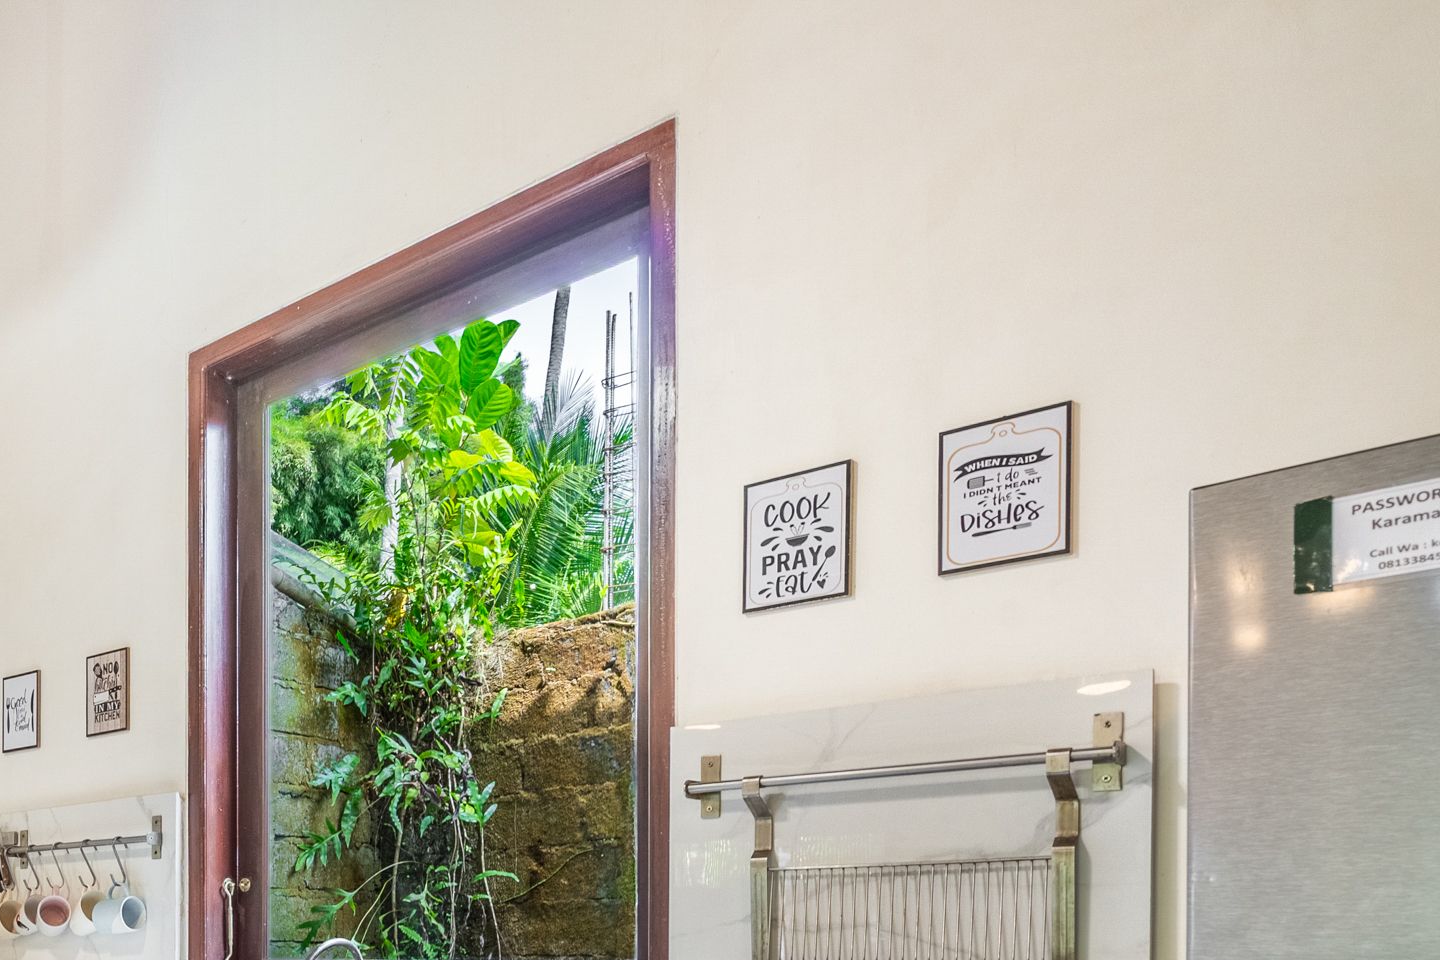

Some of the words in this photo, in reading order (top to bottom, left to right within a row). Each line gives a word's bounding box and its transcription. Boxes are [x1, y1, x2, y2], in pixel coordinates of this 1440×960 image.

[964, 458, 999, 473] WHEN
[1001, 456, 1007, 466] I
[1008, 454, 1038, 466] SAID
[1005, 467, 1019, 482] do
[1005, 476, 1042, 490] MEANT
[764, 492, 831, 527] COOK
[1351, 488, 1440, 515] PASSWOR
[1370, 546, 1393, 558] Call
[1397, 543, 1419, 553] Wa
[762, 545, 822, 576] PRAY
[95, 711, 120, 723] KITCHEN
